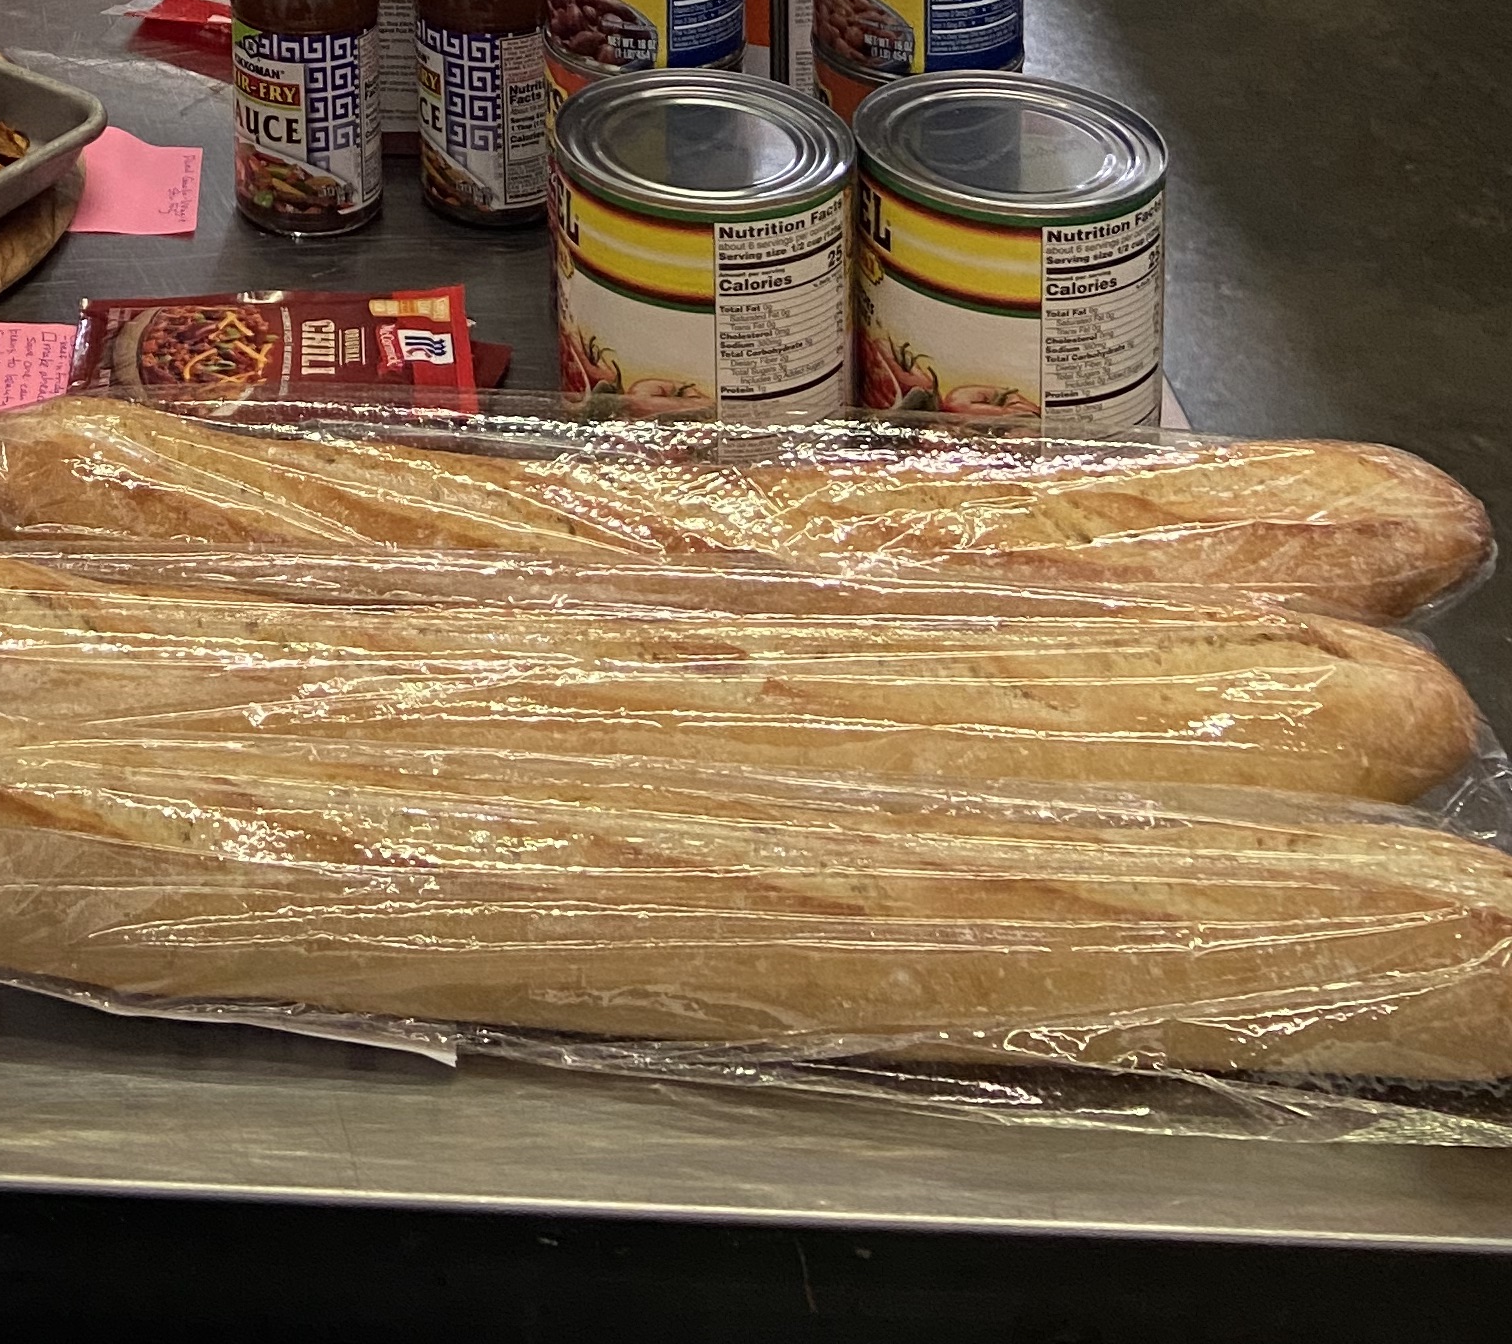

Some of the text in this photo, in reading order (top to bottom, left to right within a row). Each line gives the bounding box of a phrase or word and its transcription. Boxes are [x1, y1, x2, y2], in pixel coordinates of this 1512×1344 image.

[864, 33, 878, 44] NET
[892, 49, 908, 61] 454
[237, 57, 281, 80] KKOMAN
[238, 75, 299, 104] IR-FRY
[509, 92, 542, 106] Facts
[719, 197, 843, 239] Nutrition Facts
[1046, 198, 1162, 244] Nutrition Facts
[718, 231, 808, 252] about 6 servings per
[719, 251, 764, 262] Serving
[765, 247, 788, 259] size
[1045, 250, 1114, 265] Serving size
[718, 243, 843, 292] Calories 25
[1045, 277, 1118, 297] Calories
[719, 304, 744, 313] Total
[745, 305, 761, 313] Fat
[39, 342, 52, 369] make
[301, 319, 336, 375] CHILI
[344, 328, 361, 363] ORIGINAL
[378, 323, 405, 368] McCormick
